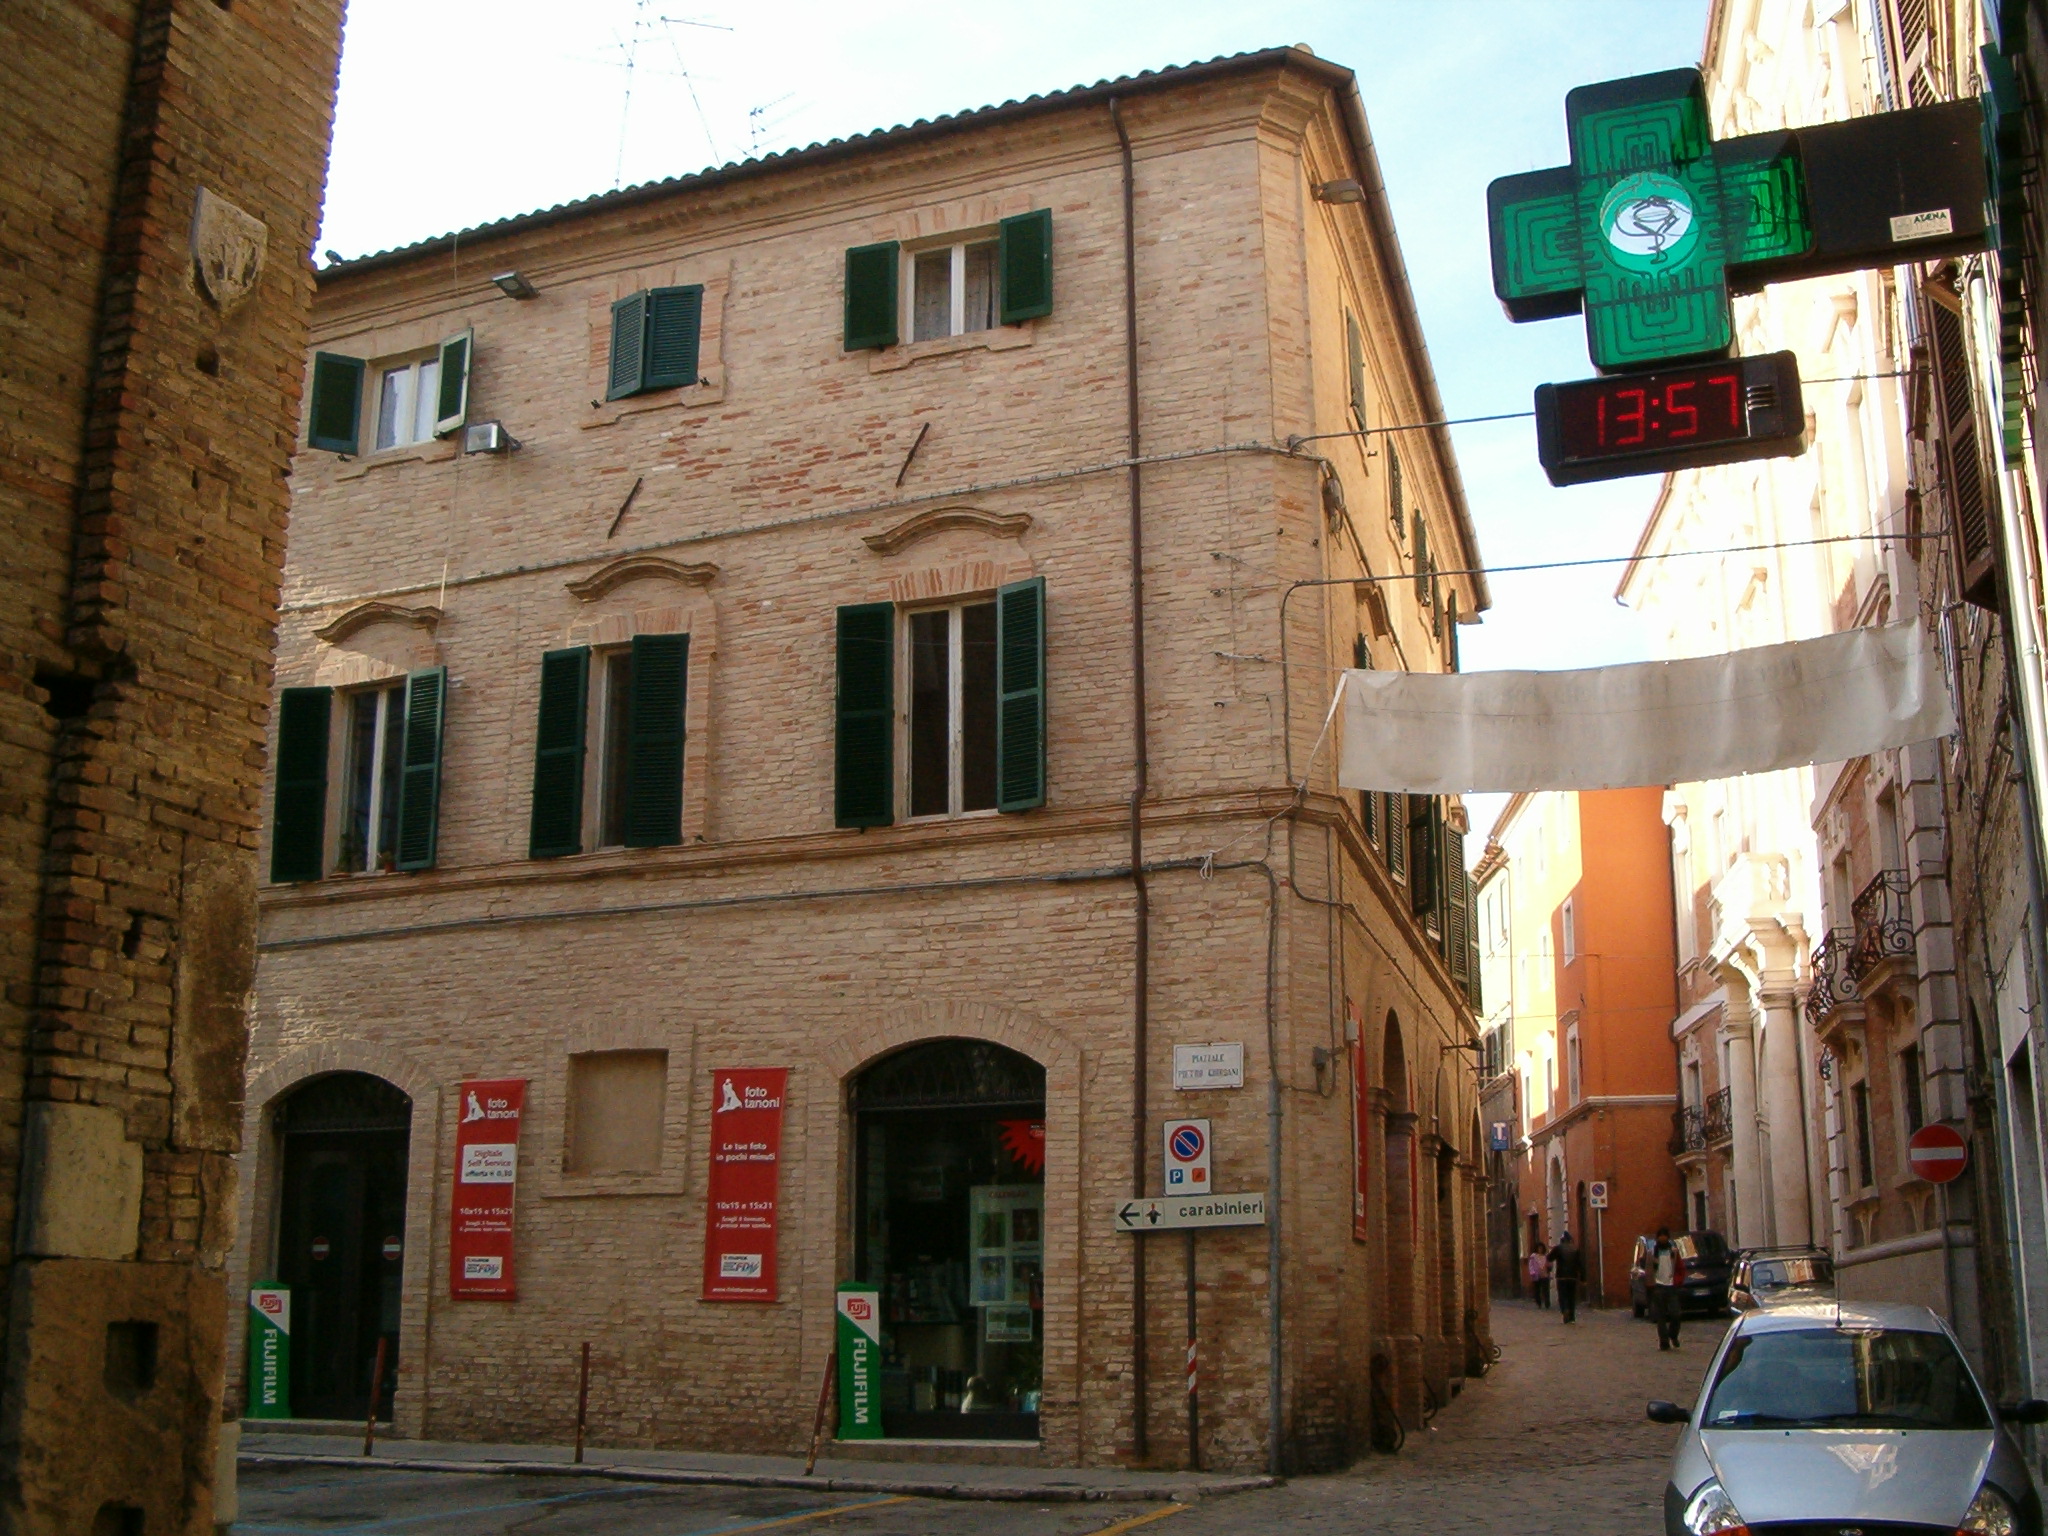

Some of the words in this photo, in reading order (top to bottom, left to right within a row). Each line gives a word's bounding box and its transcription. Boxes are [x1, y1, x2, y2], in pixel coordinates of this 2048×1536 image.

[1598, 376, 1738, 446] 13:57
[1192, 1054, 1224, 1063] PIAZZALE
[745, 1086, 767, 1097] foto
[488, 1098, 508, 1108] foto
[744, 1097, 780, 1108] tanoni
[488, 1108, 519, 1119] tanoni
[750, 1142, 767, 1150] foto
[726, 1153, 747, 1162] pochi
[749, 1152, 776, 1160] minuti
[1173, 1172, 1181, 1182] P
[1179, 1200, 1263, 1217] carabinieri
[264, 1328, 277, 1404] FUJIFILM
[854, 1338, 869, 1424] FUJIFILM
